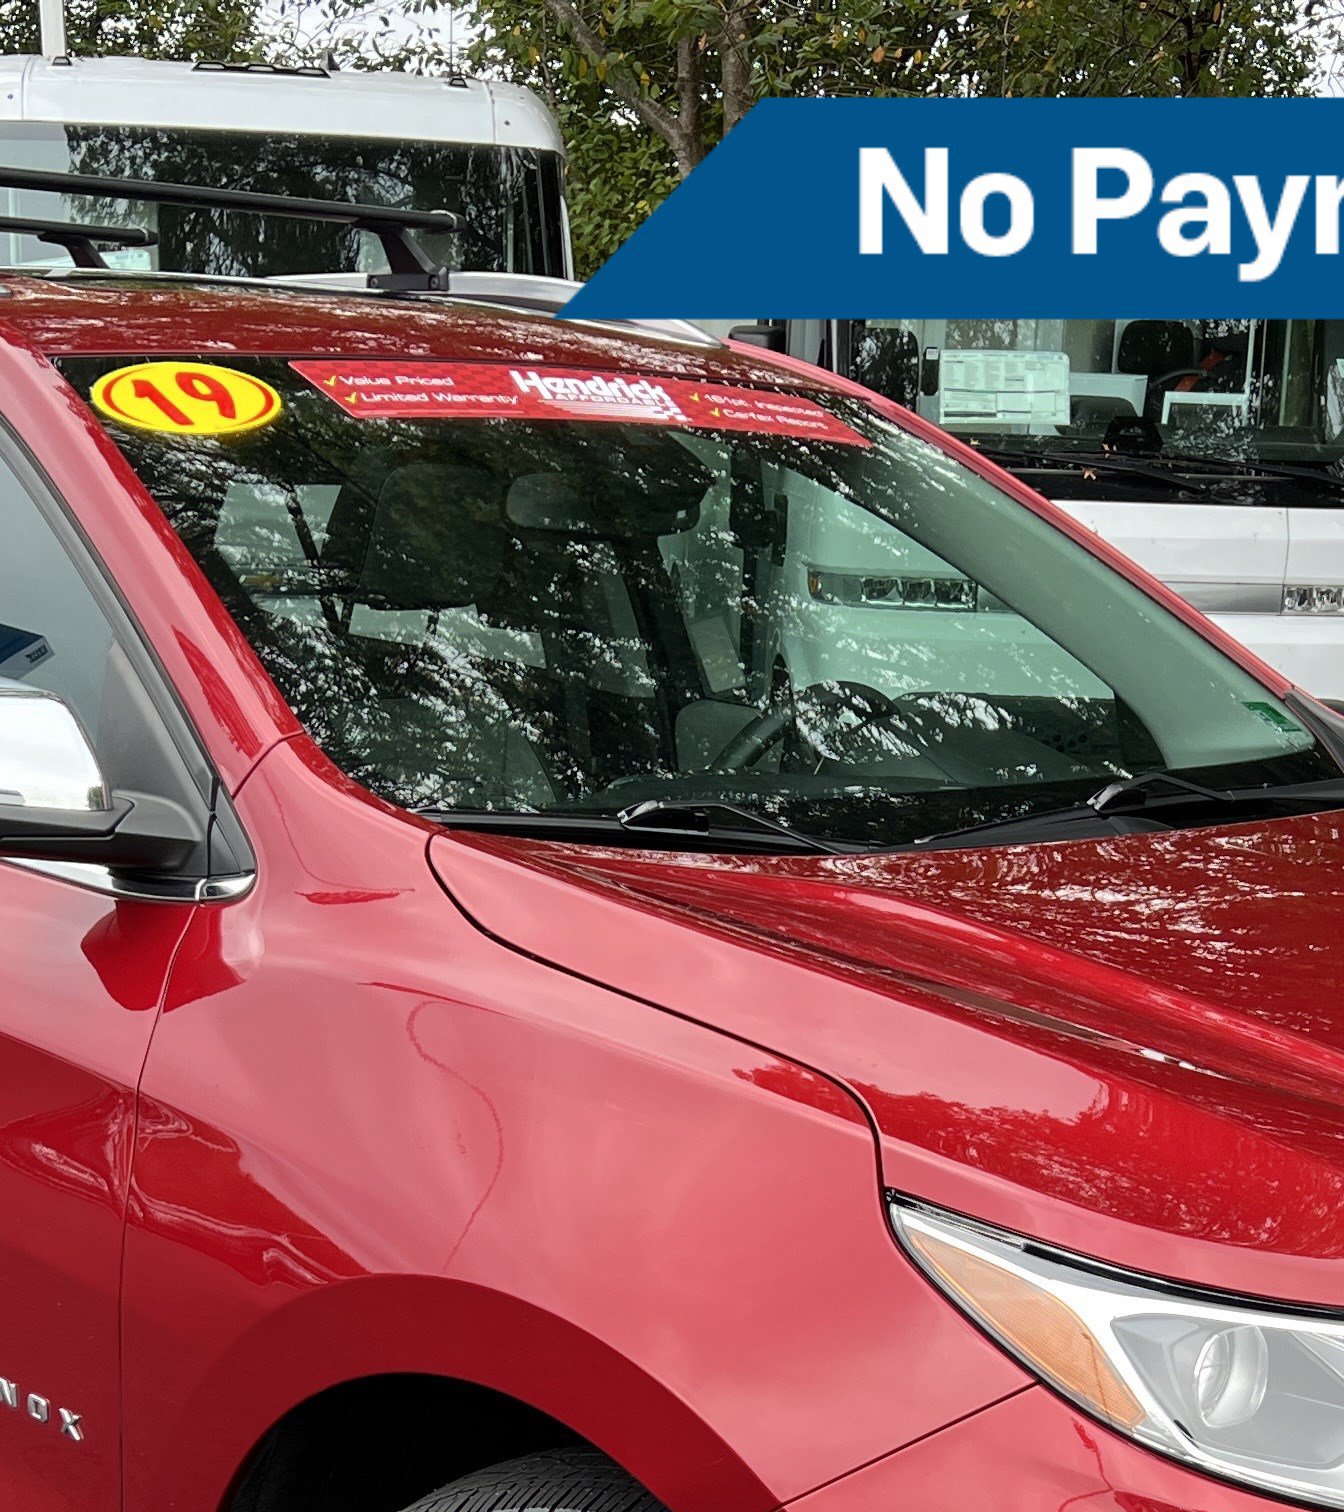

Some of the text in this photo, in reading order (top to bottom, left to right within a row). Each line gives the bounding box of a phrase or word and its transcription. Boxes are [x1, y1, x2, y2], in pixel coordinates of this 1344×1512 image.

[339, 375, 454, 386] Value Priced
[510, 370, 676, 407] Hendrick
[132, 372, 236, 425] 19
[361, 392, 519, 405] Limited Warranty
